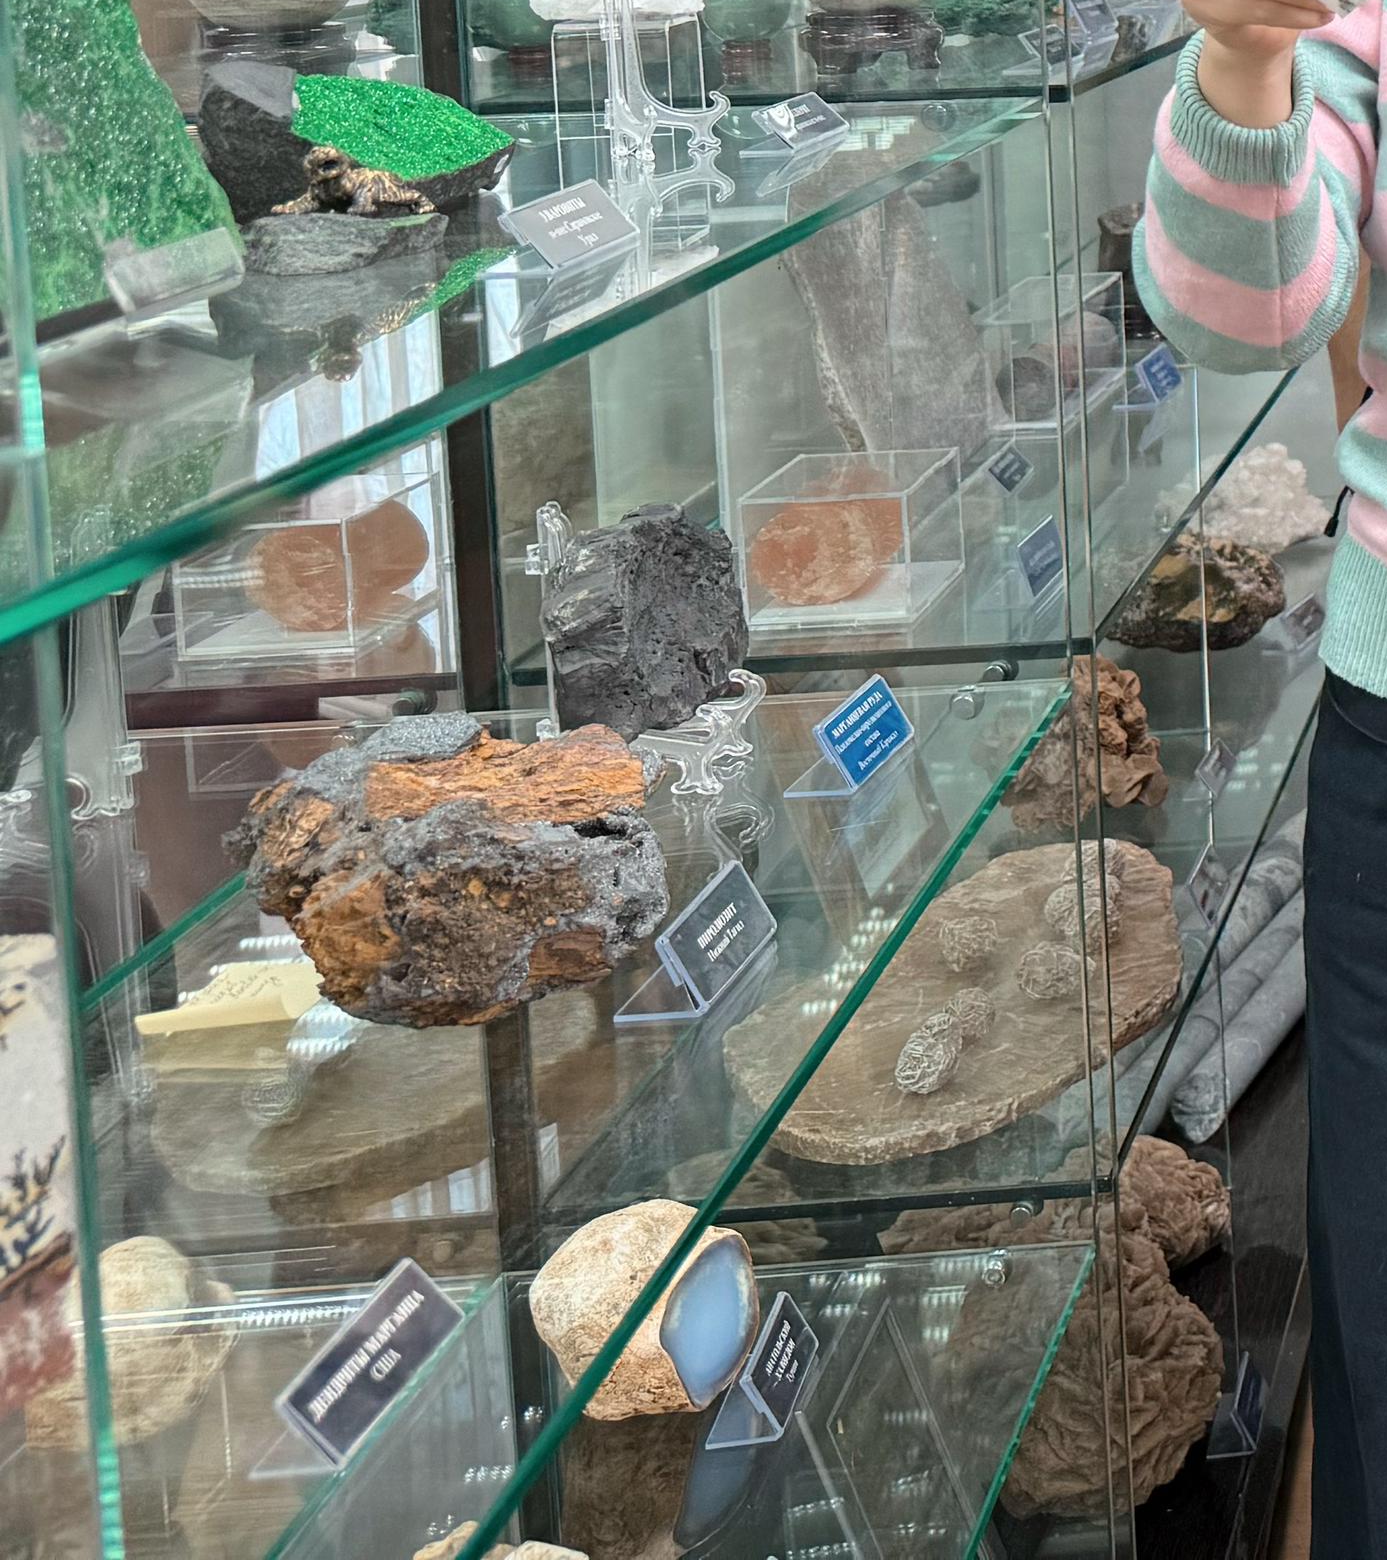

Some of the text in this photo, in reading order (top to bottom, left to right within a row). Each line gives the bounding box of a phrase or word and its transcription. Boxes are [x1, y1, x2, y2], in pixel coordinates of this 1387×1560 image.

[696, 902, 738, 950] ПИРОЛЮЗИТ
[307, 1289, 426, 1423] ДЕНДРИТЫ МАРГАНЦА
[368, 1347, 403, 1382] США
